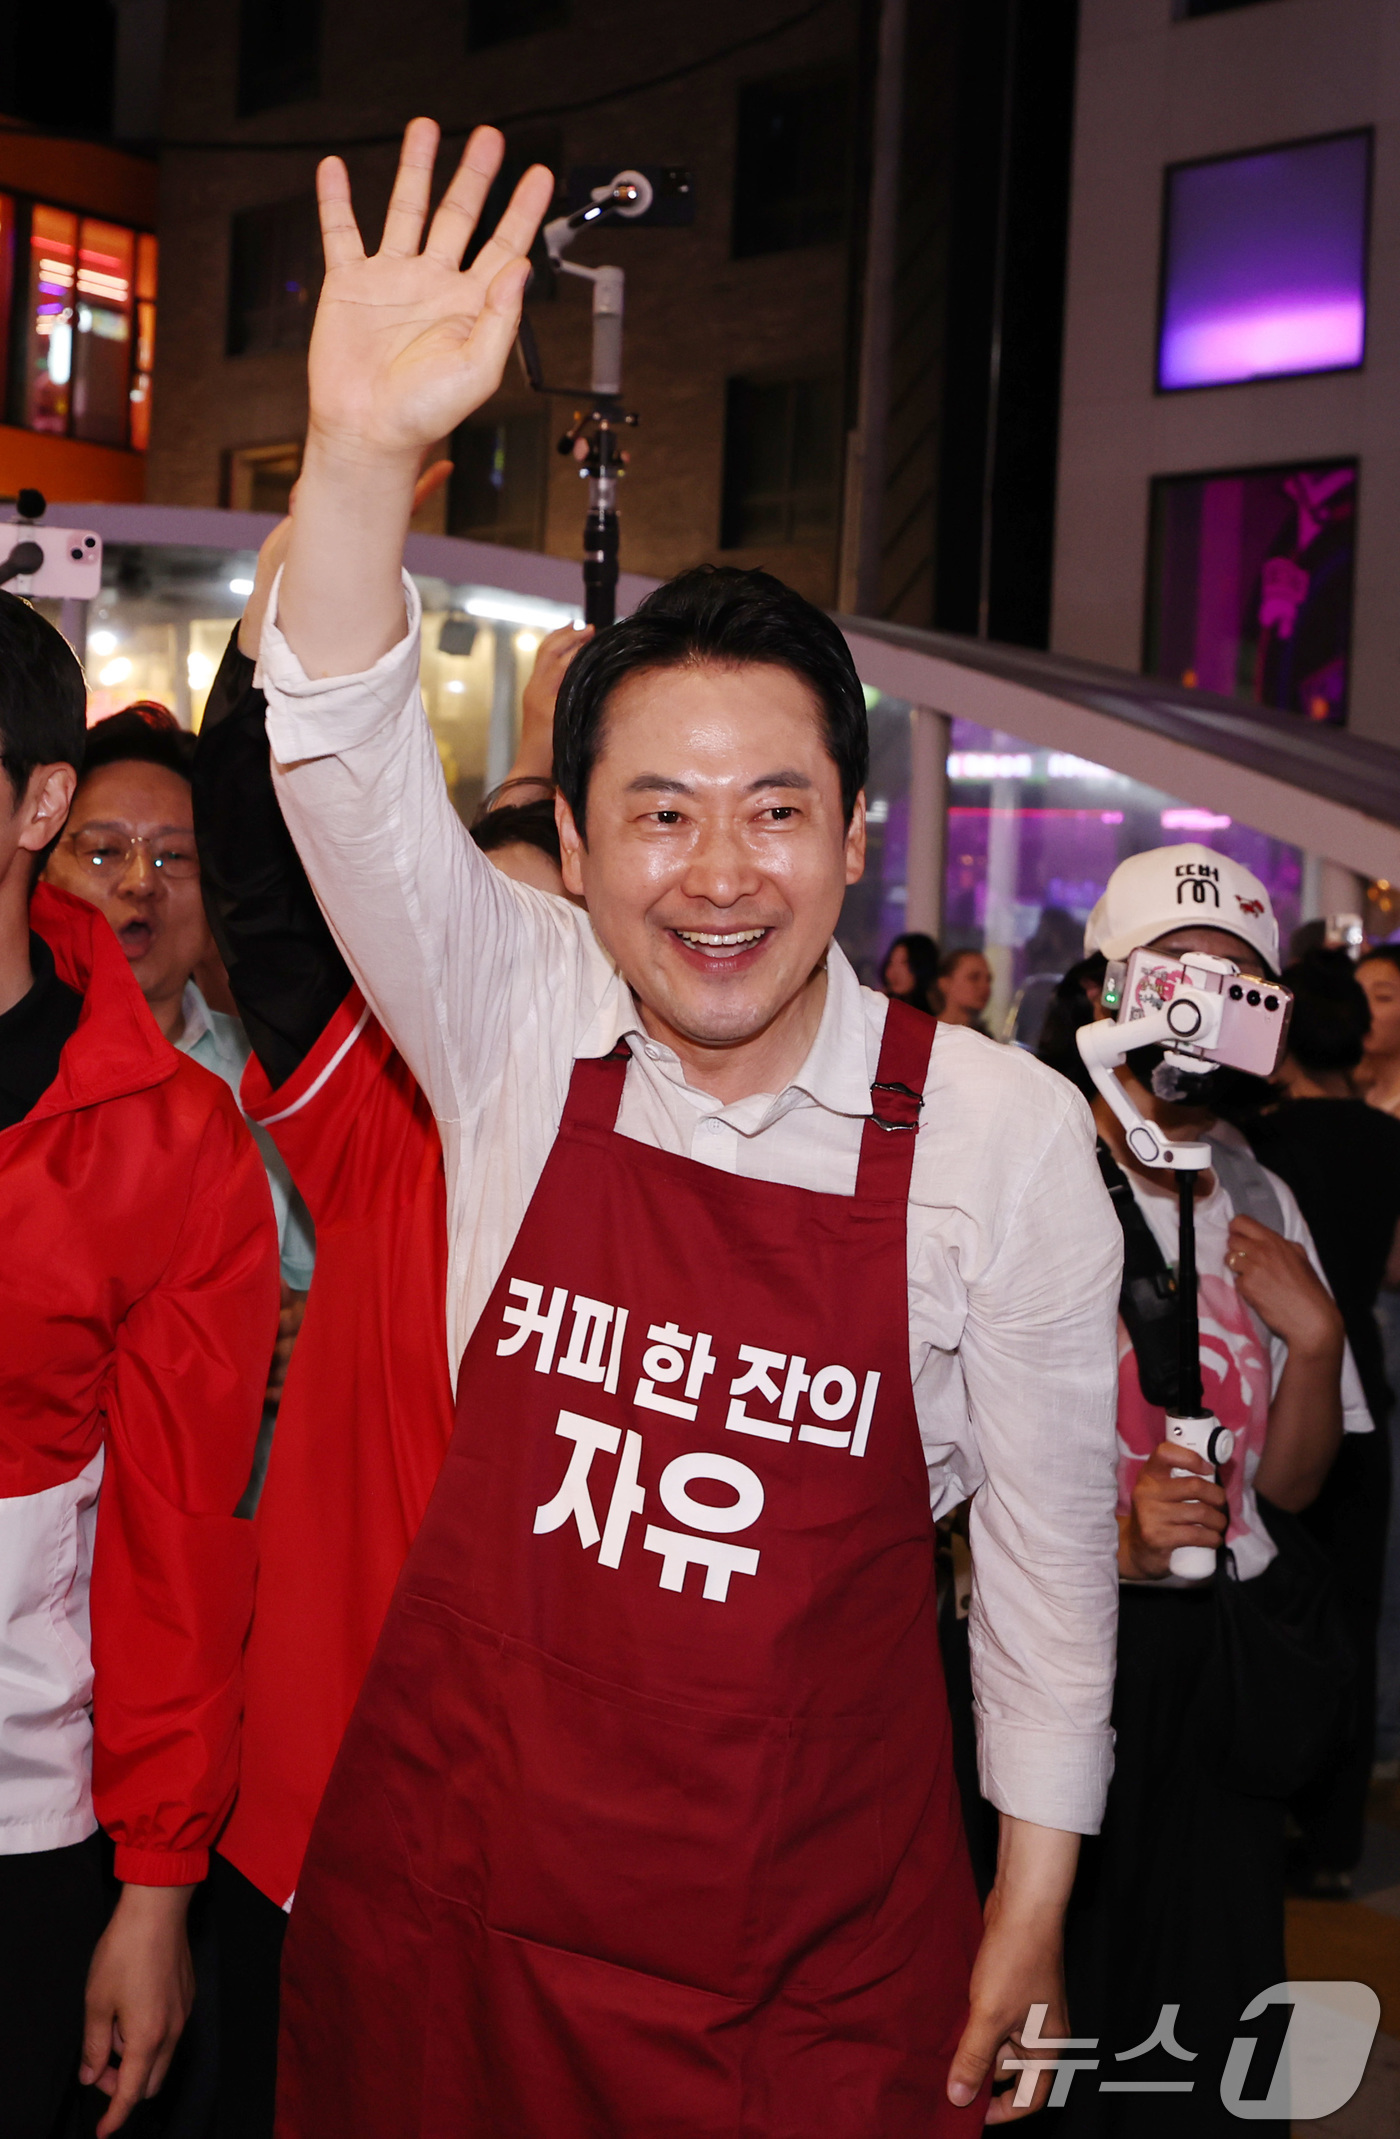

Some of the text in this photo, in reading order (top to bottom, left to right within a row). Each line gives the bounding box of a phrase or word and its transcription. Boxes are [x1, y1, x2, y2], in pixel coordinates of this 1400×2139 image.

[496, 1277, 881, 1458] 커피 한 잔의
[532, 1409, 765, 1603] 자유
